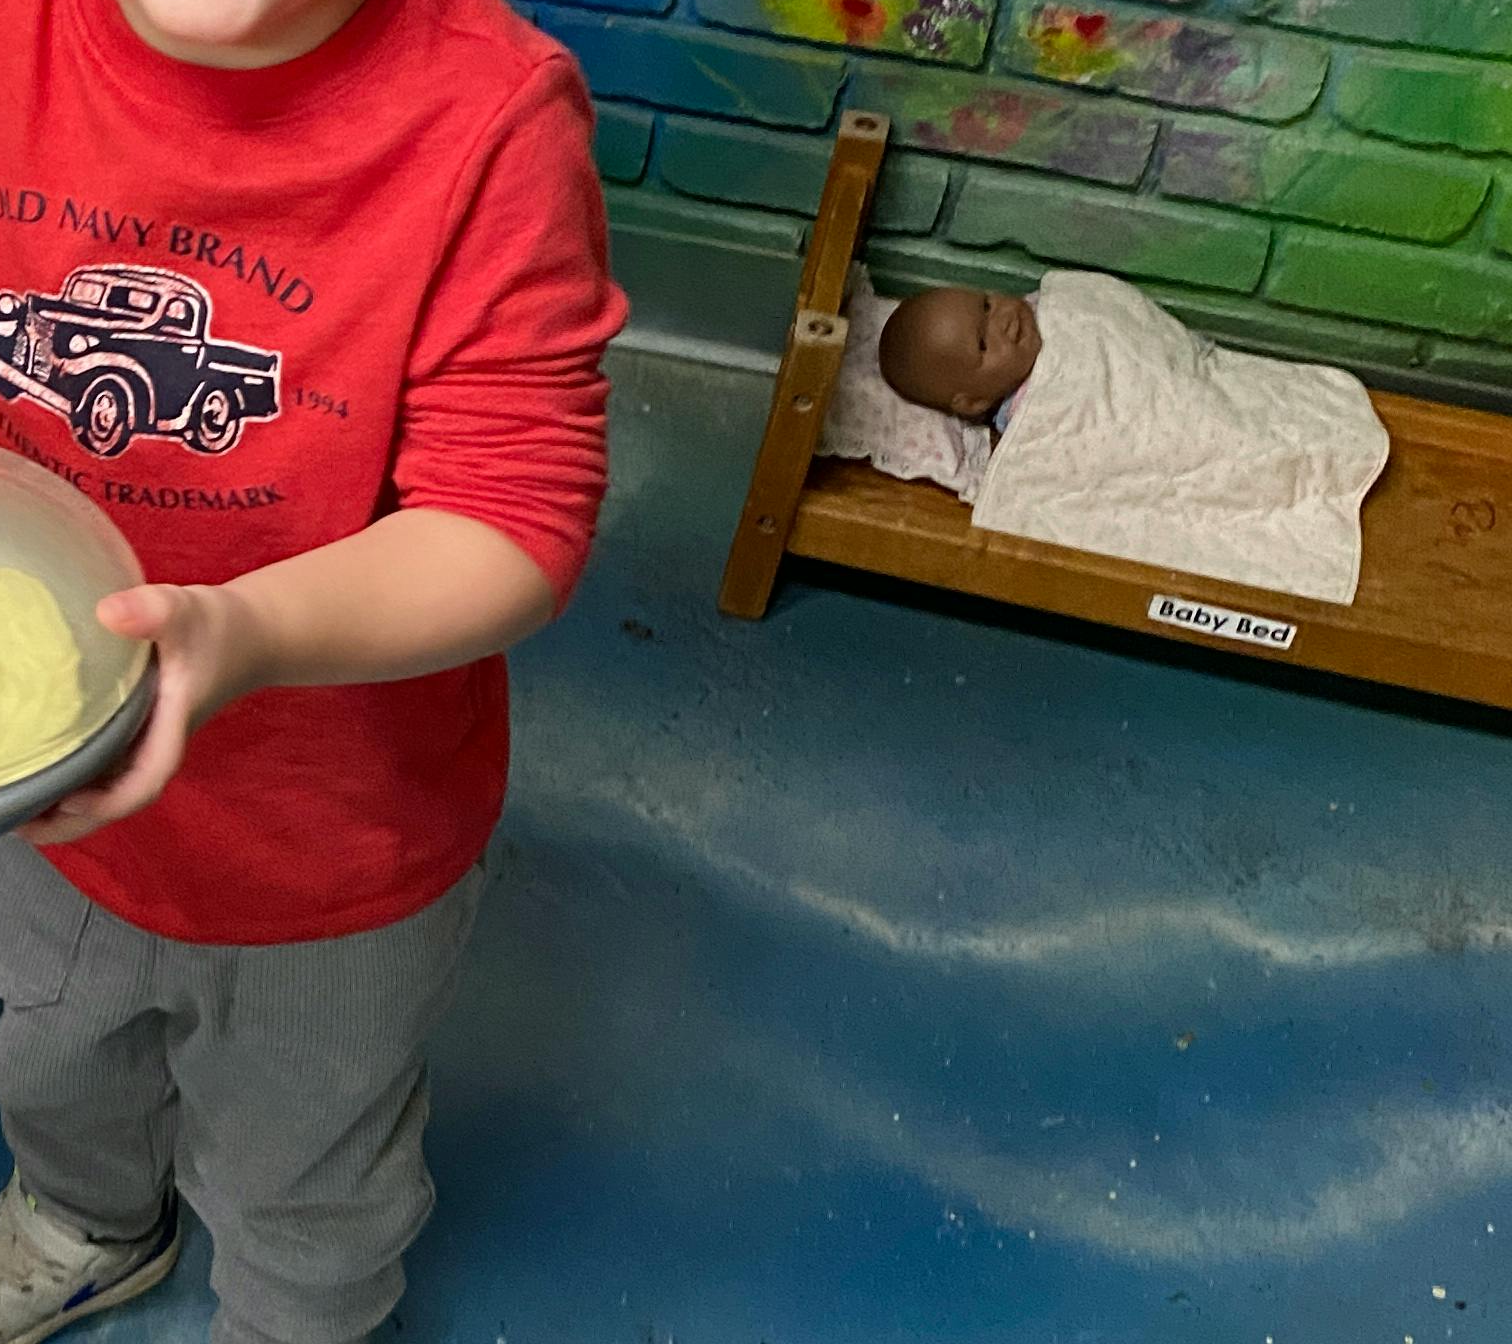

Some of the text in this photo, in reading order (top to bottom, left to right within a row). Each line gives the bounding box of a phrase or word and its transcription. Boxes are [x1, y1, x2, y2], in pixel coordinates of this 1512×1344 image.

[59, 197, 154, 249] NAVY
[168, 225, 314, 314] BRAND
[103, 480, 286, 511] TRADEMARK
[1159, 600, 1291, 643] Baby Bed
